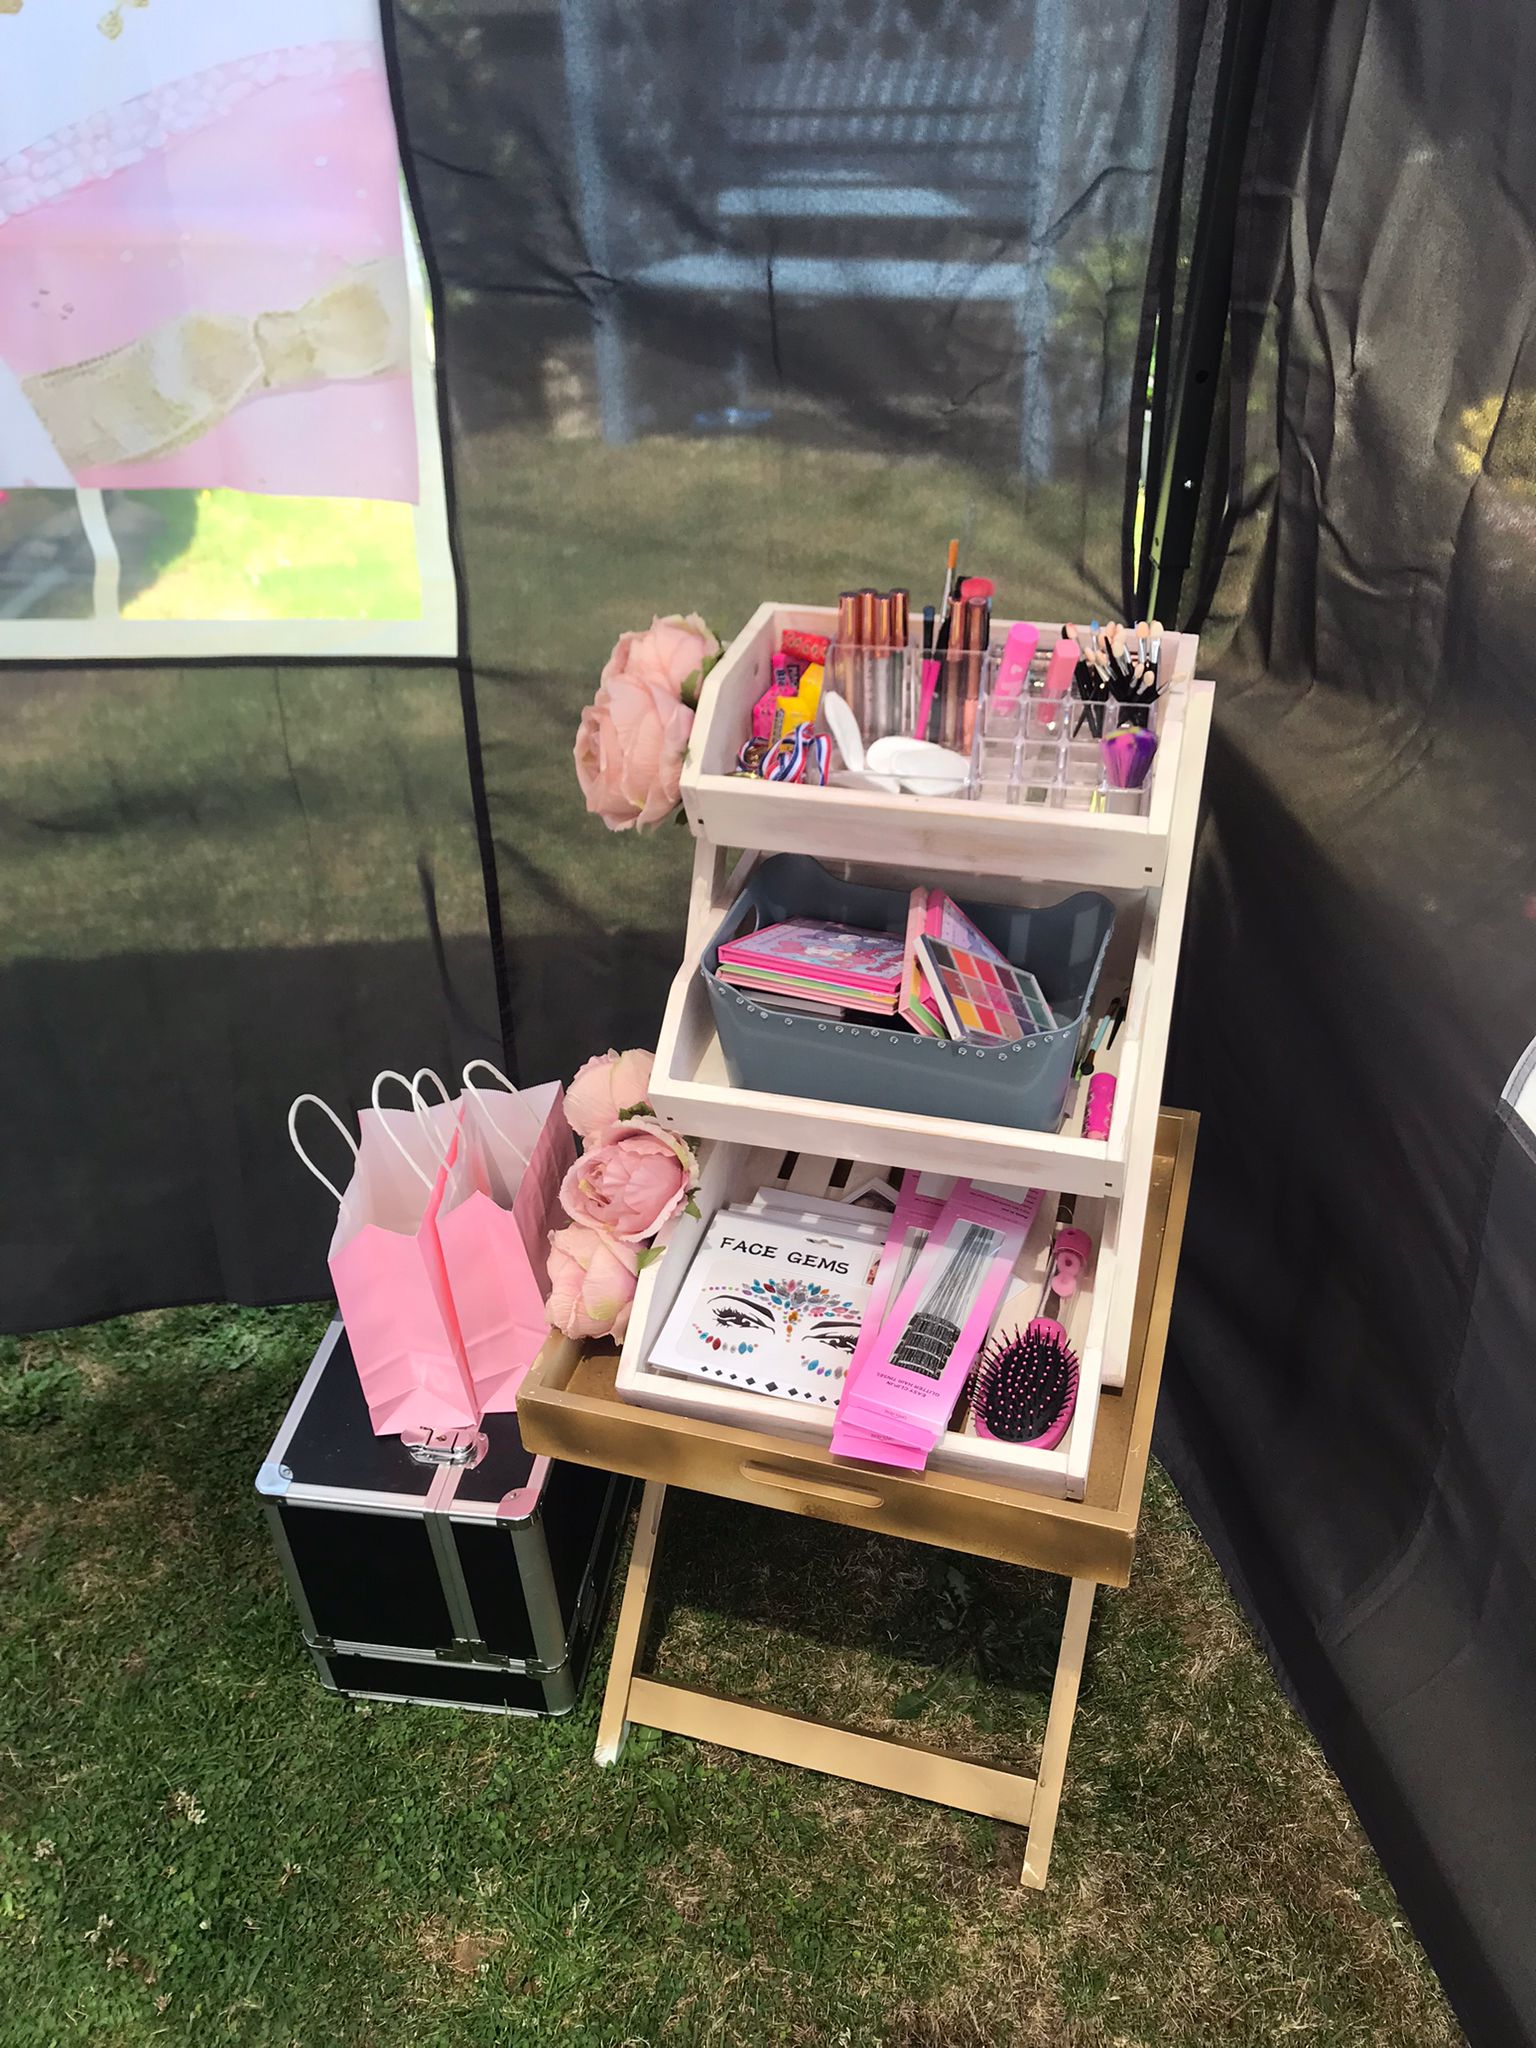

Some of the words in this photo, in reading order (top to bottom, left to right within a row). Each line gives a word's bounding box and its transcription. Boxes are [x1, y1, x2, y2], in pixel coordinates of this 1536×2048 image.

[720, 1237, 778, 1259] FACE
[787, 1251, 850, 1275] GEMS
[876, 1371, 896, 1381] TINSEL
[897, 1379, 914, 1388] HAIR
[909, 1388, 927, 1398] EASY
[913, 1384, 940, 1397] GLITTER
